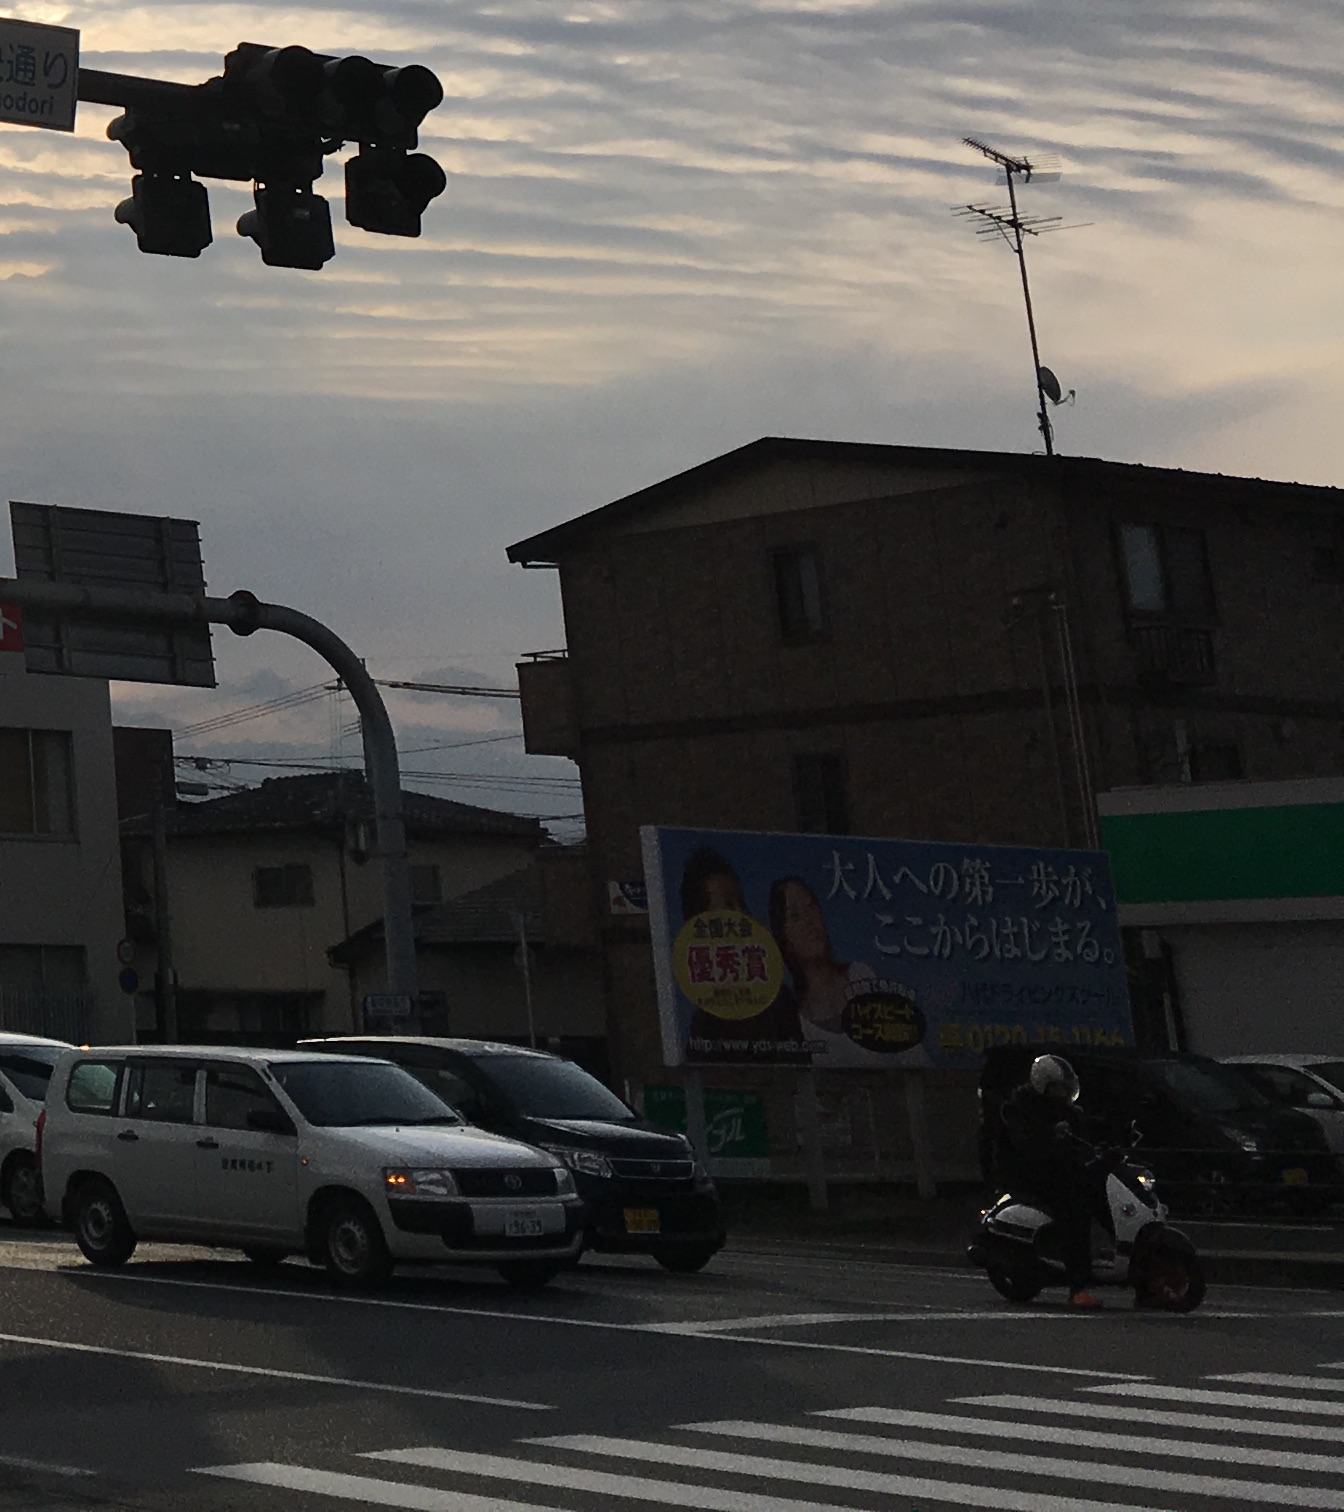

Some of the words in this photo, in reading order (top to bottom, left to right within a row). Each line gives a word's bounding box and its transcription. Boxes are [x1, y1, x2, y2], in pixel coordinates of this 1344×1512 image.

[823, 853, 1107, 910] 大人への第一歩が、
[874, 914, 1115, 965] ここからはじまる。
